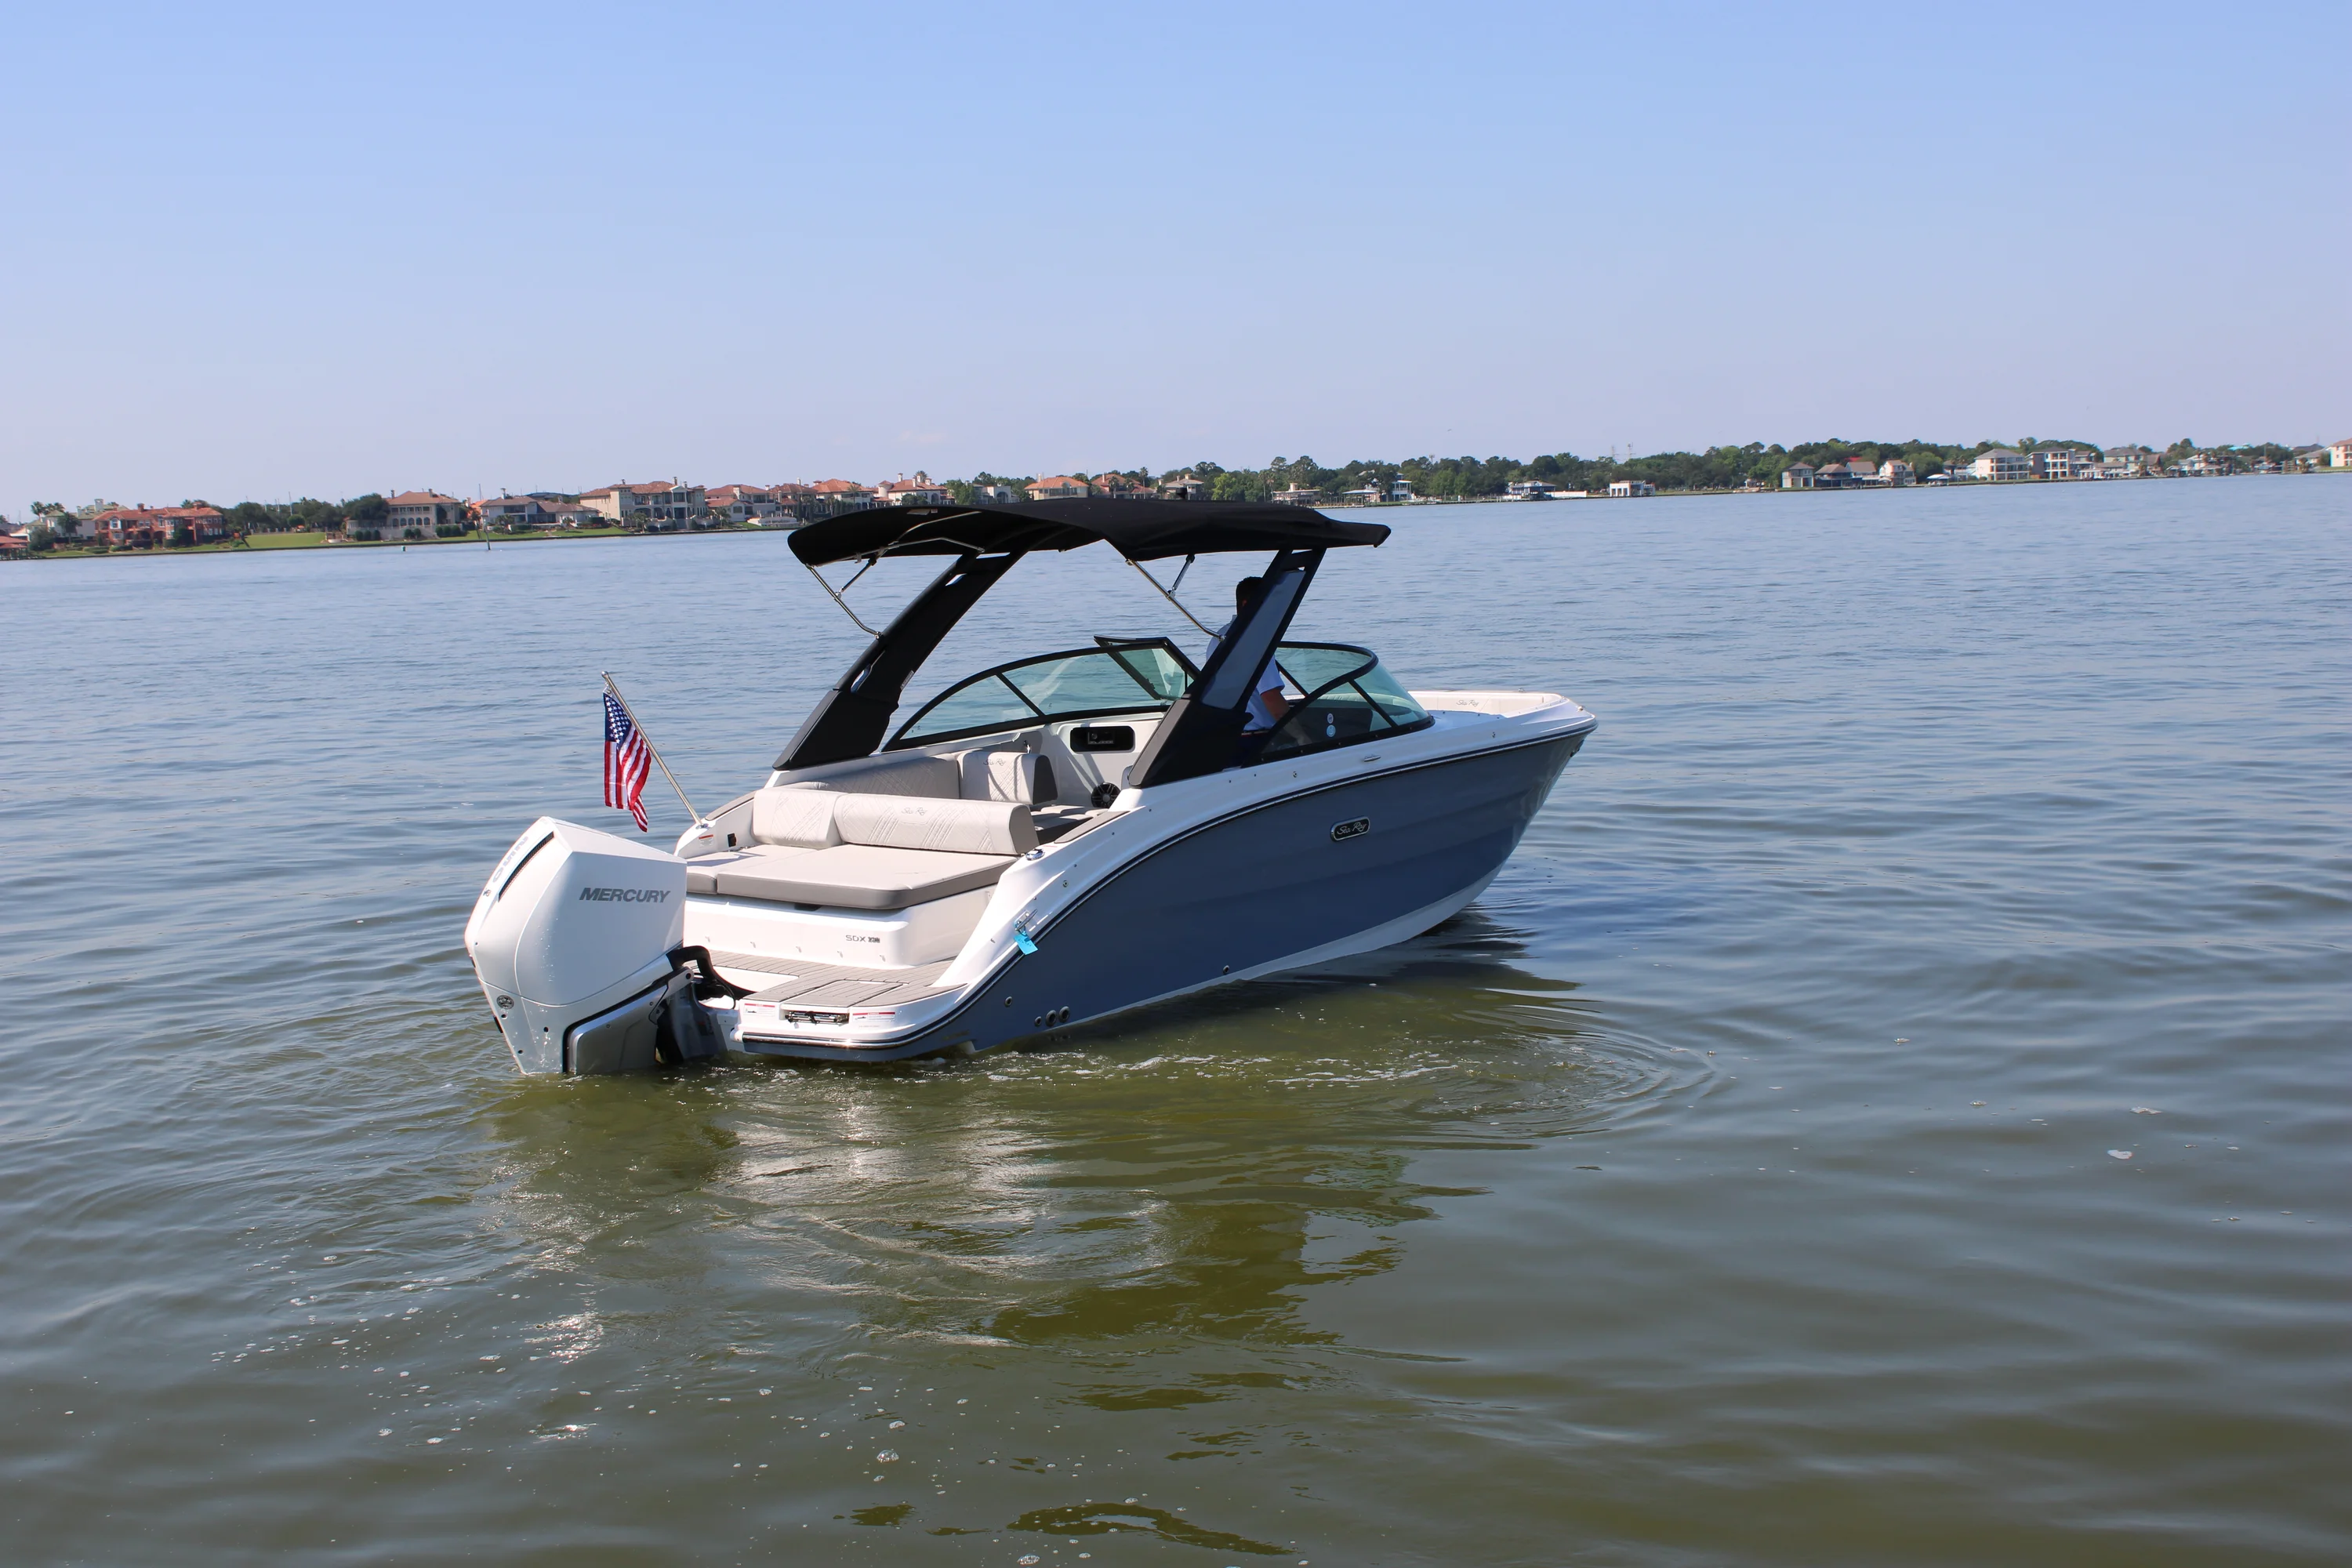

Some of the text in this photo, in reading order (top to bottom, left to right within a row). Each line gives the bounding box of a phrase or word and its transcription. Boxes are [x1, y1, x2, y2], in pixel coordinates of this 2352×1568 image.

[1337, 822, 1367, 835] Sea Ray
[579, 887, 671, 903] MERCURY
[845, 935, 866, 943] SDX
